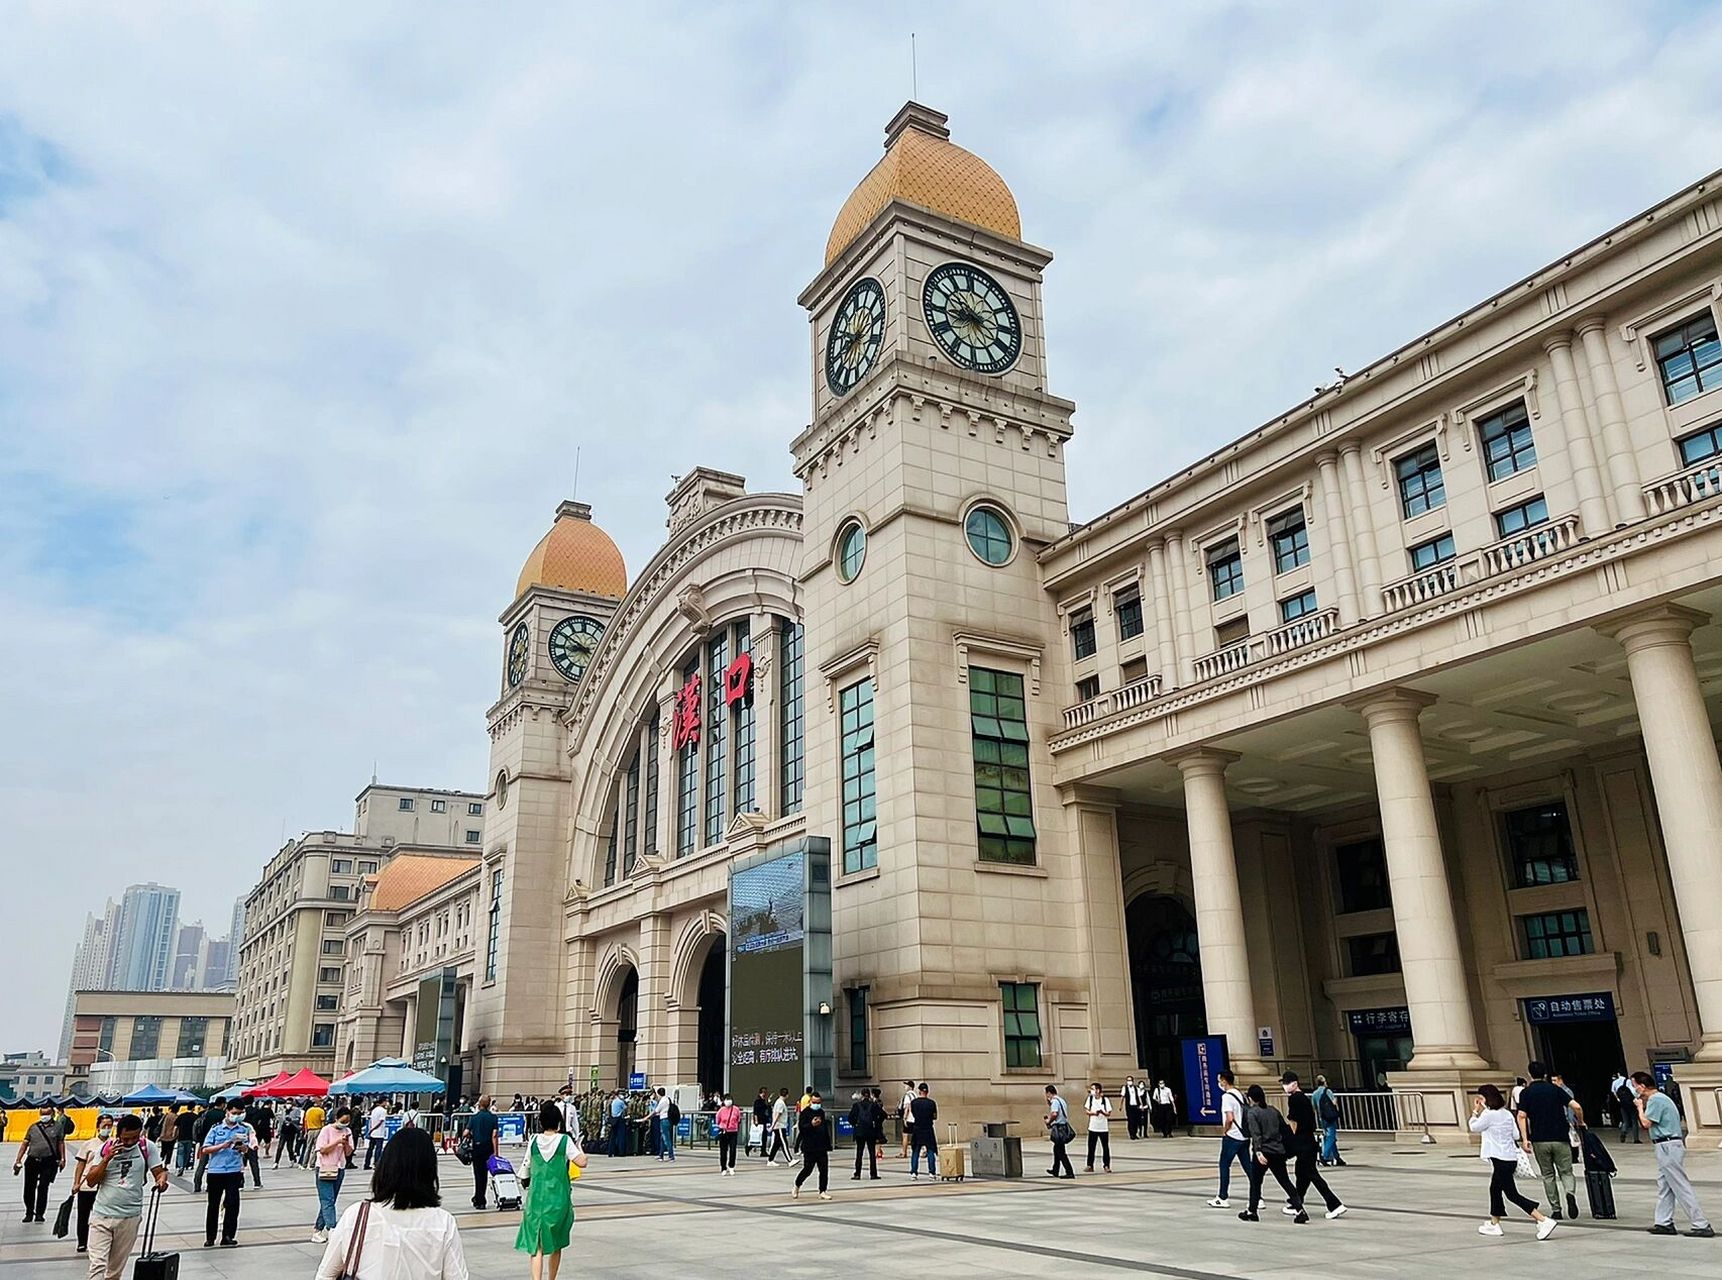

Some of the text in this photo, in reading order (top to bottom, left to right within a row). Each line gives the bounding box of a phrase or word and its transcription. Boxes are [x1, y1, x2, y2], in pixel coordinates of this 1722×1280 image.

[1550, 998, 1606, 1012] 自动售票处
[1366, 1010, 1409, 1025] 行李寄存
